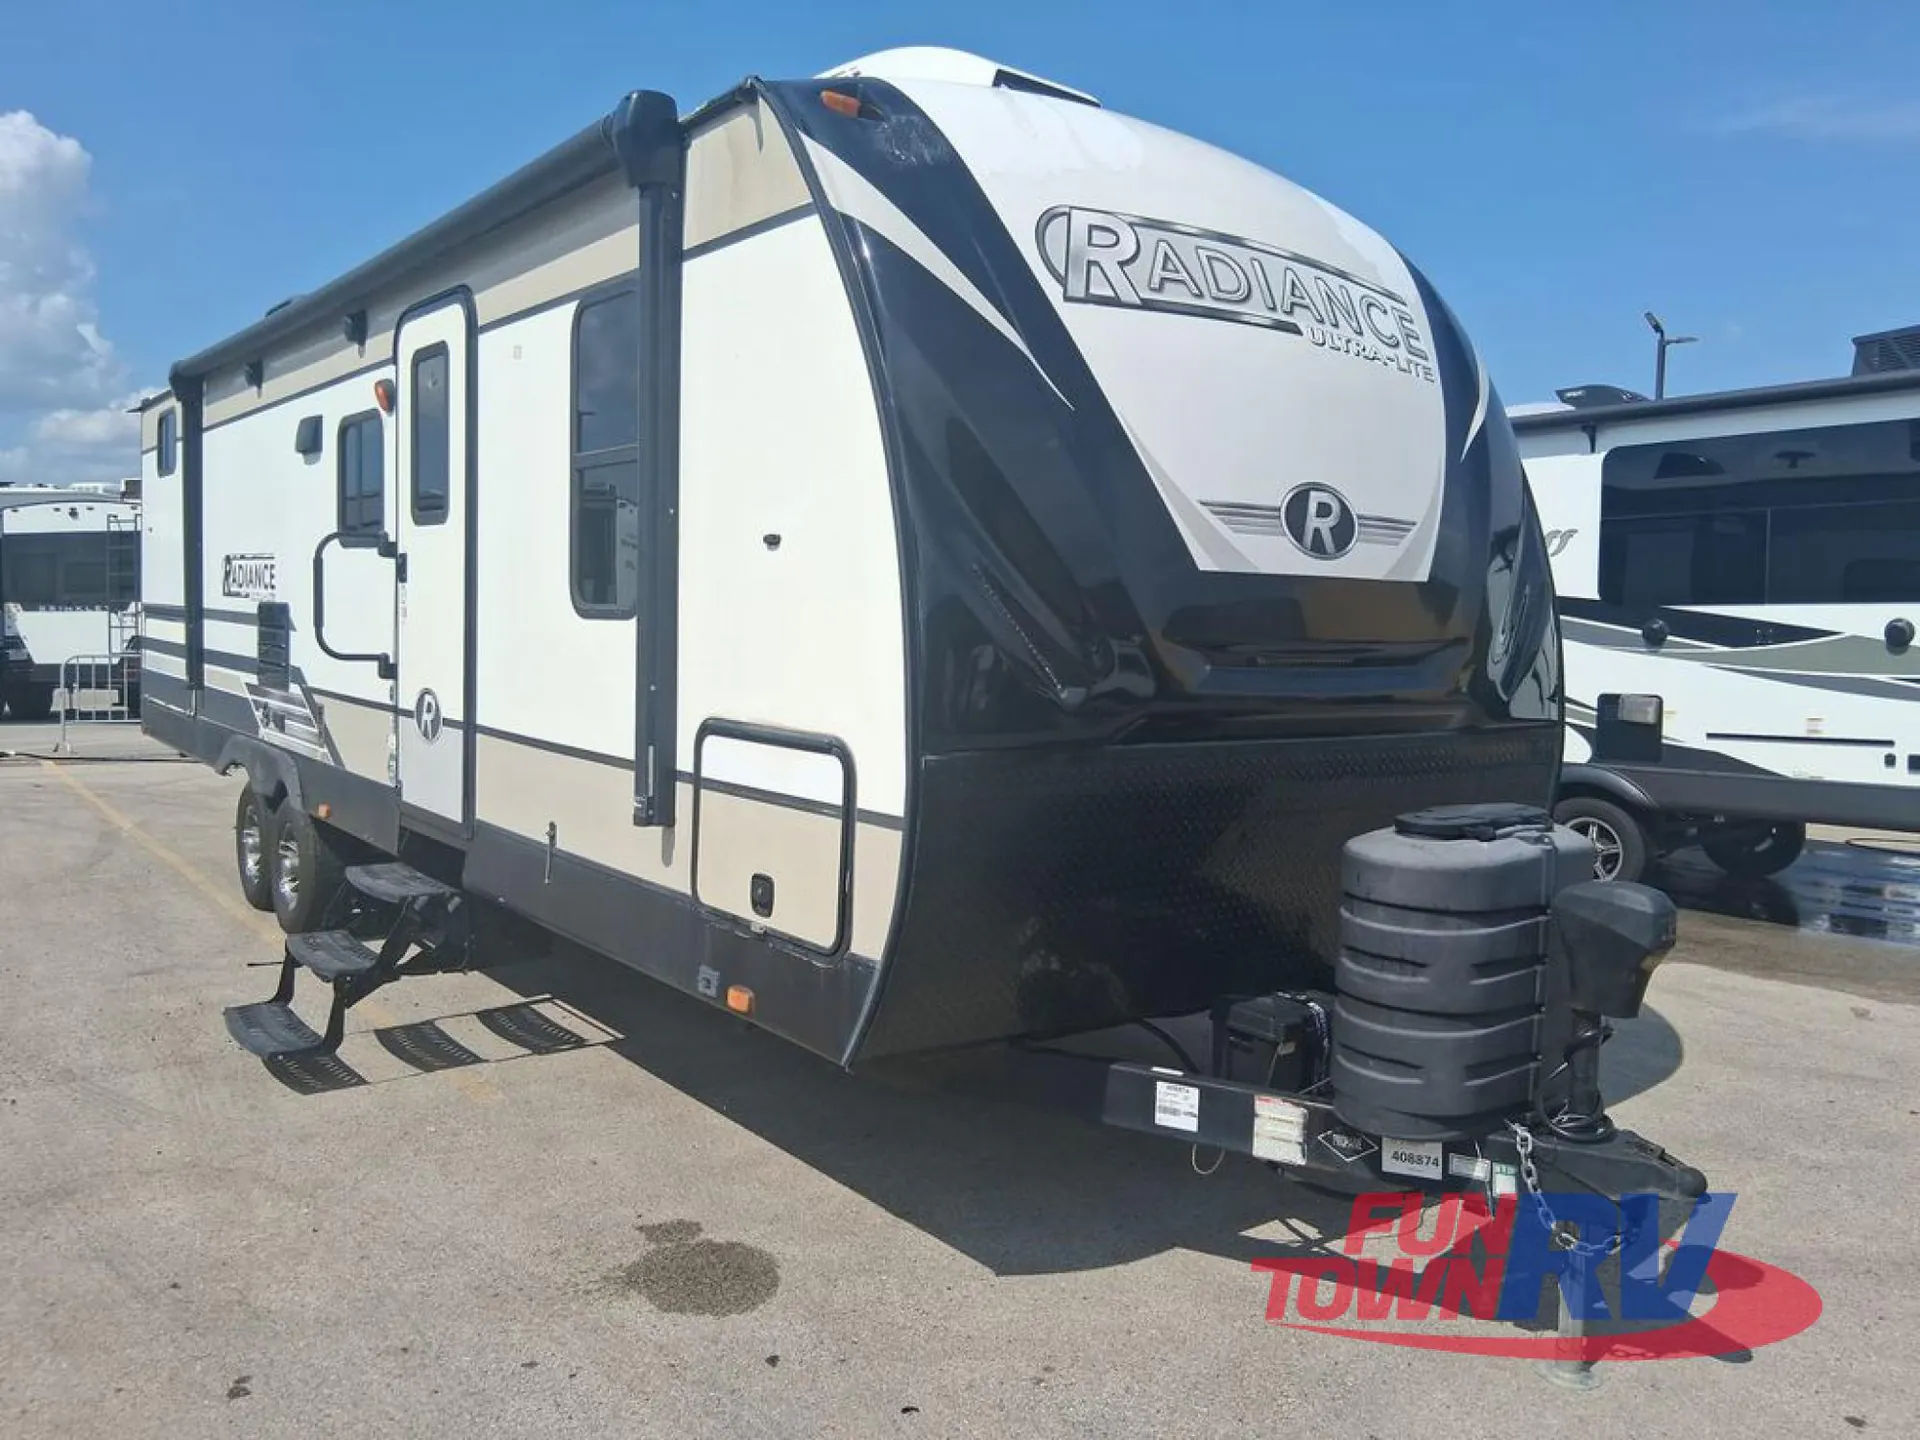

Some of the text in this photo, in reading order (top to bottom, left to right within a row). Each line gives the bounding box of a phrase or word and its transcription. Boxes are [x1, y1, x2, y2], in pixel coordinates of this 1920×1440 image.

[1062, 206, 1430, 362] RADIANCE
[1307, 325, 1435, 384] ULTRA-LITE
[1302, 490, 1342, 555] R
[222, 554, 276, 597] RADIANCE
[1391, 1150, 1439, 1168] 408874
